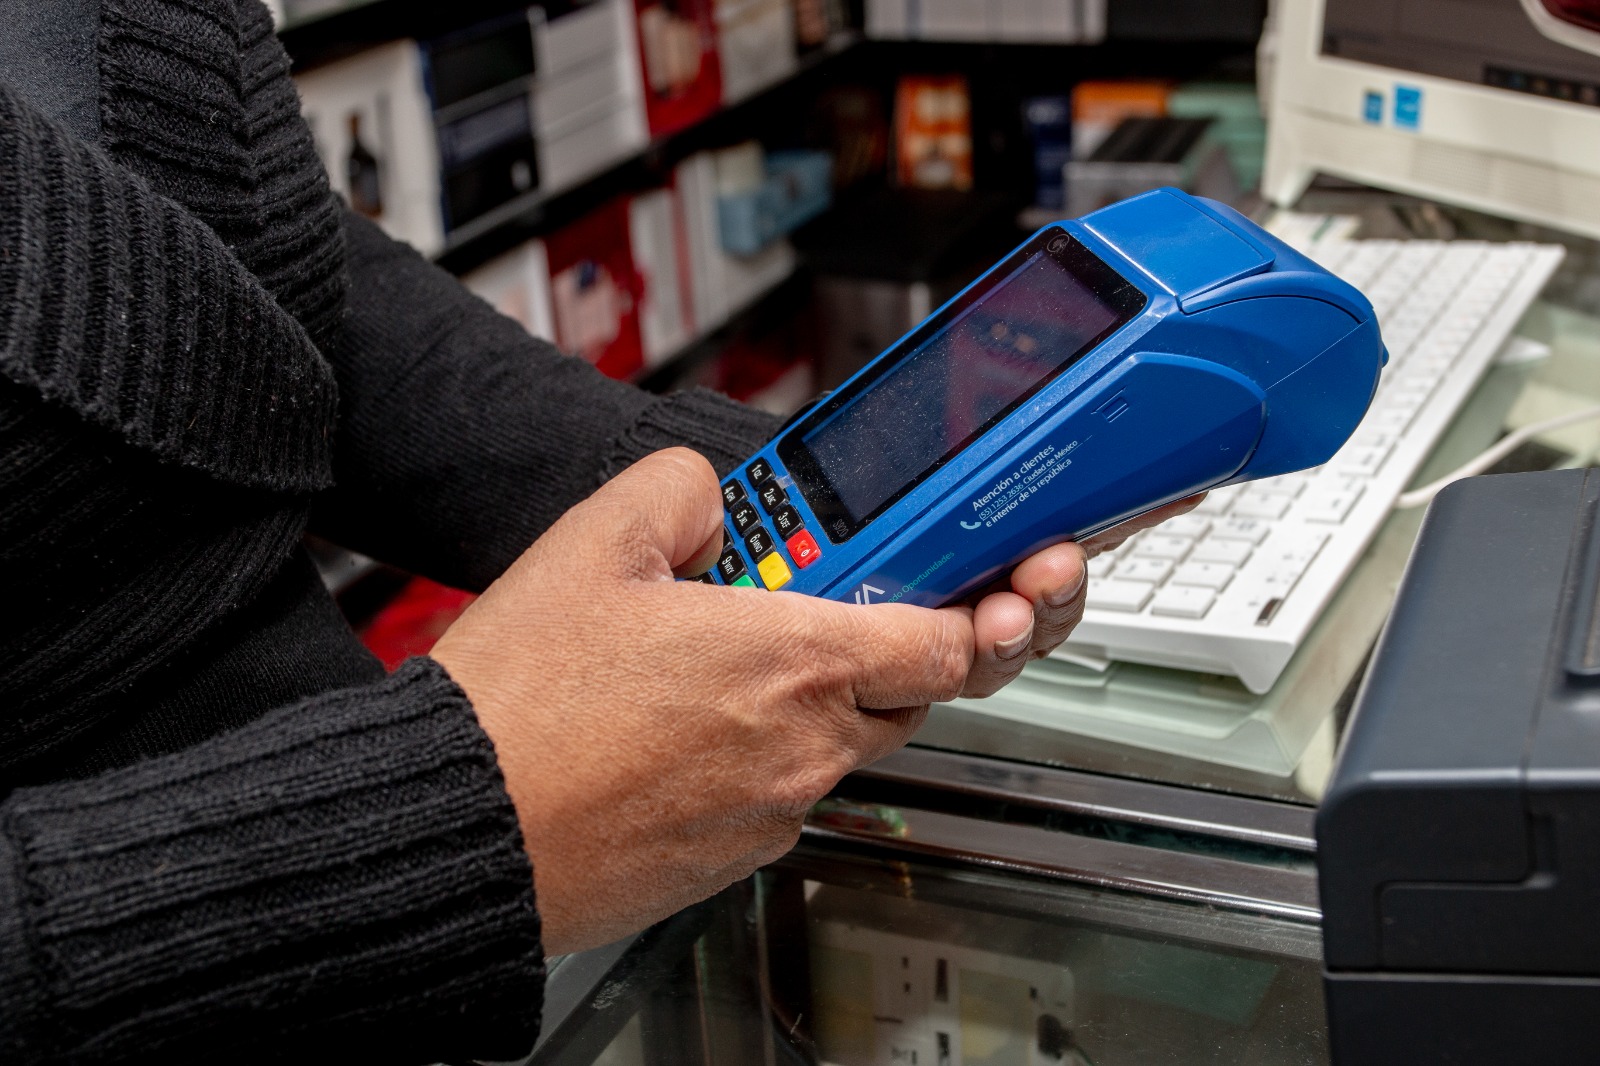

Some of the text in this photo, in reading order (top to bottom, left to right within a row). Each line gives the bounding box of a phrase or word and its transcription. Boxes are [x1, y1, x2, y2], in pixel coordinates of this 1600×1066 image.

[972, 445, 1055, 512] Atención a clientes
[991, 495, 1008, 510] 1253
[1006, 483, 1024, 498] 2636
[1023, 464, 1047, 485] Ciudad
[1046, 457, 1056, 467] de
[1054, 440, 1079, 460] México
[992, 500, 1019, 523] interior
[1018, 491, 1030, 502] de
[1028, 485, 1039, 494] la
[1037, 458, 1073, 488] república
[901, 551, 955, 593] Oportunidades
